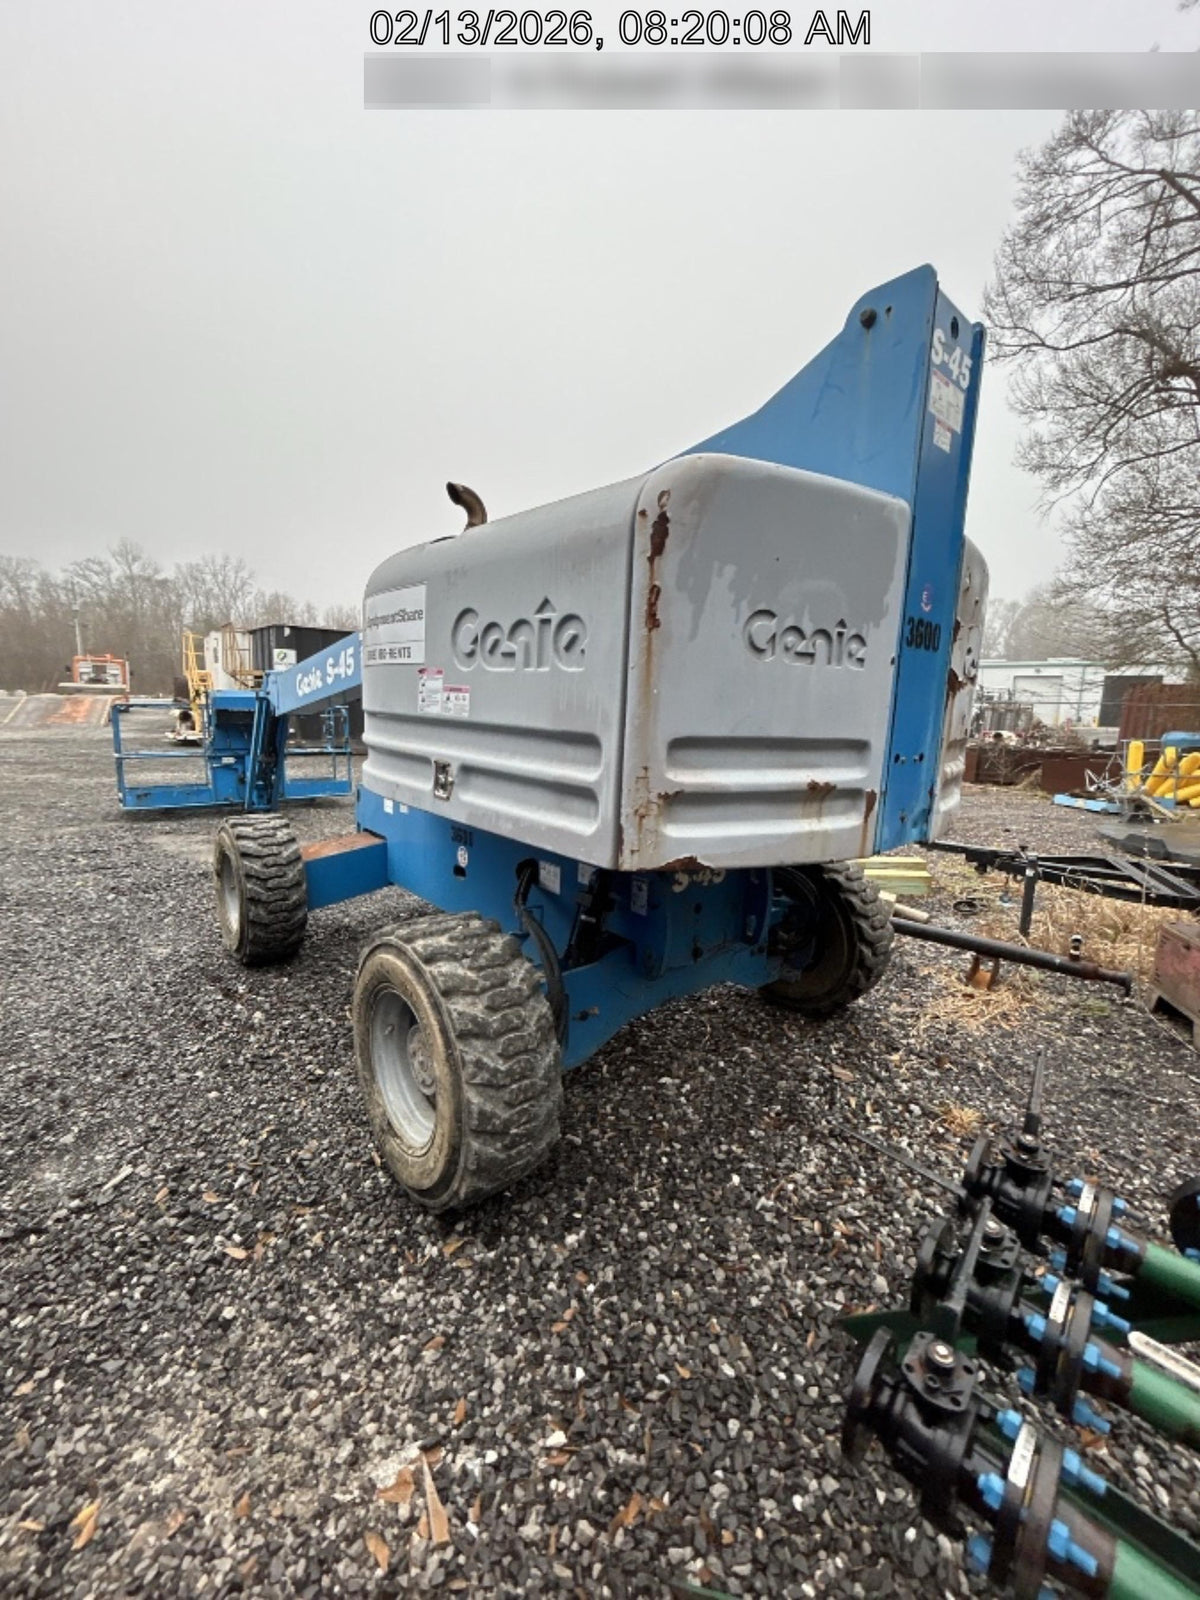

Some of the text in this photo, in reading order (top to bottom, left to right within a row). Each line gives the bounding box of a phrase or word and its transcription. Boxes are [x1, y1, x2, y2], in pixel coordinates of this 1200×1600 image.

[931, 328, 973, 390] S-45
[452, 596, 587, 671] Genie
[743, 609, 867, 671] Genie
[906, 615, 941, 653] 3600
[295, 666, 322, 697] Genie
[326, 646, 355, 685] S-45
